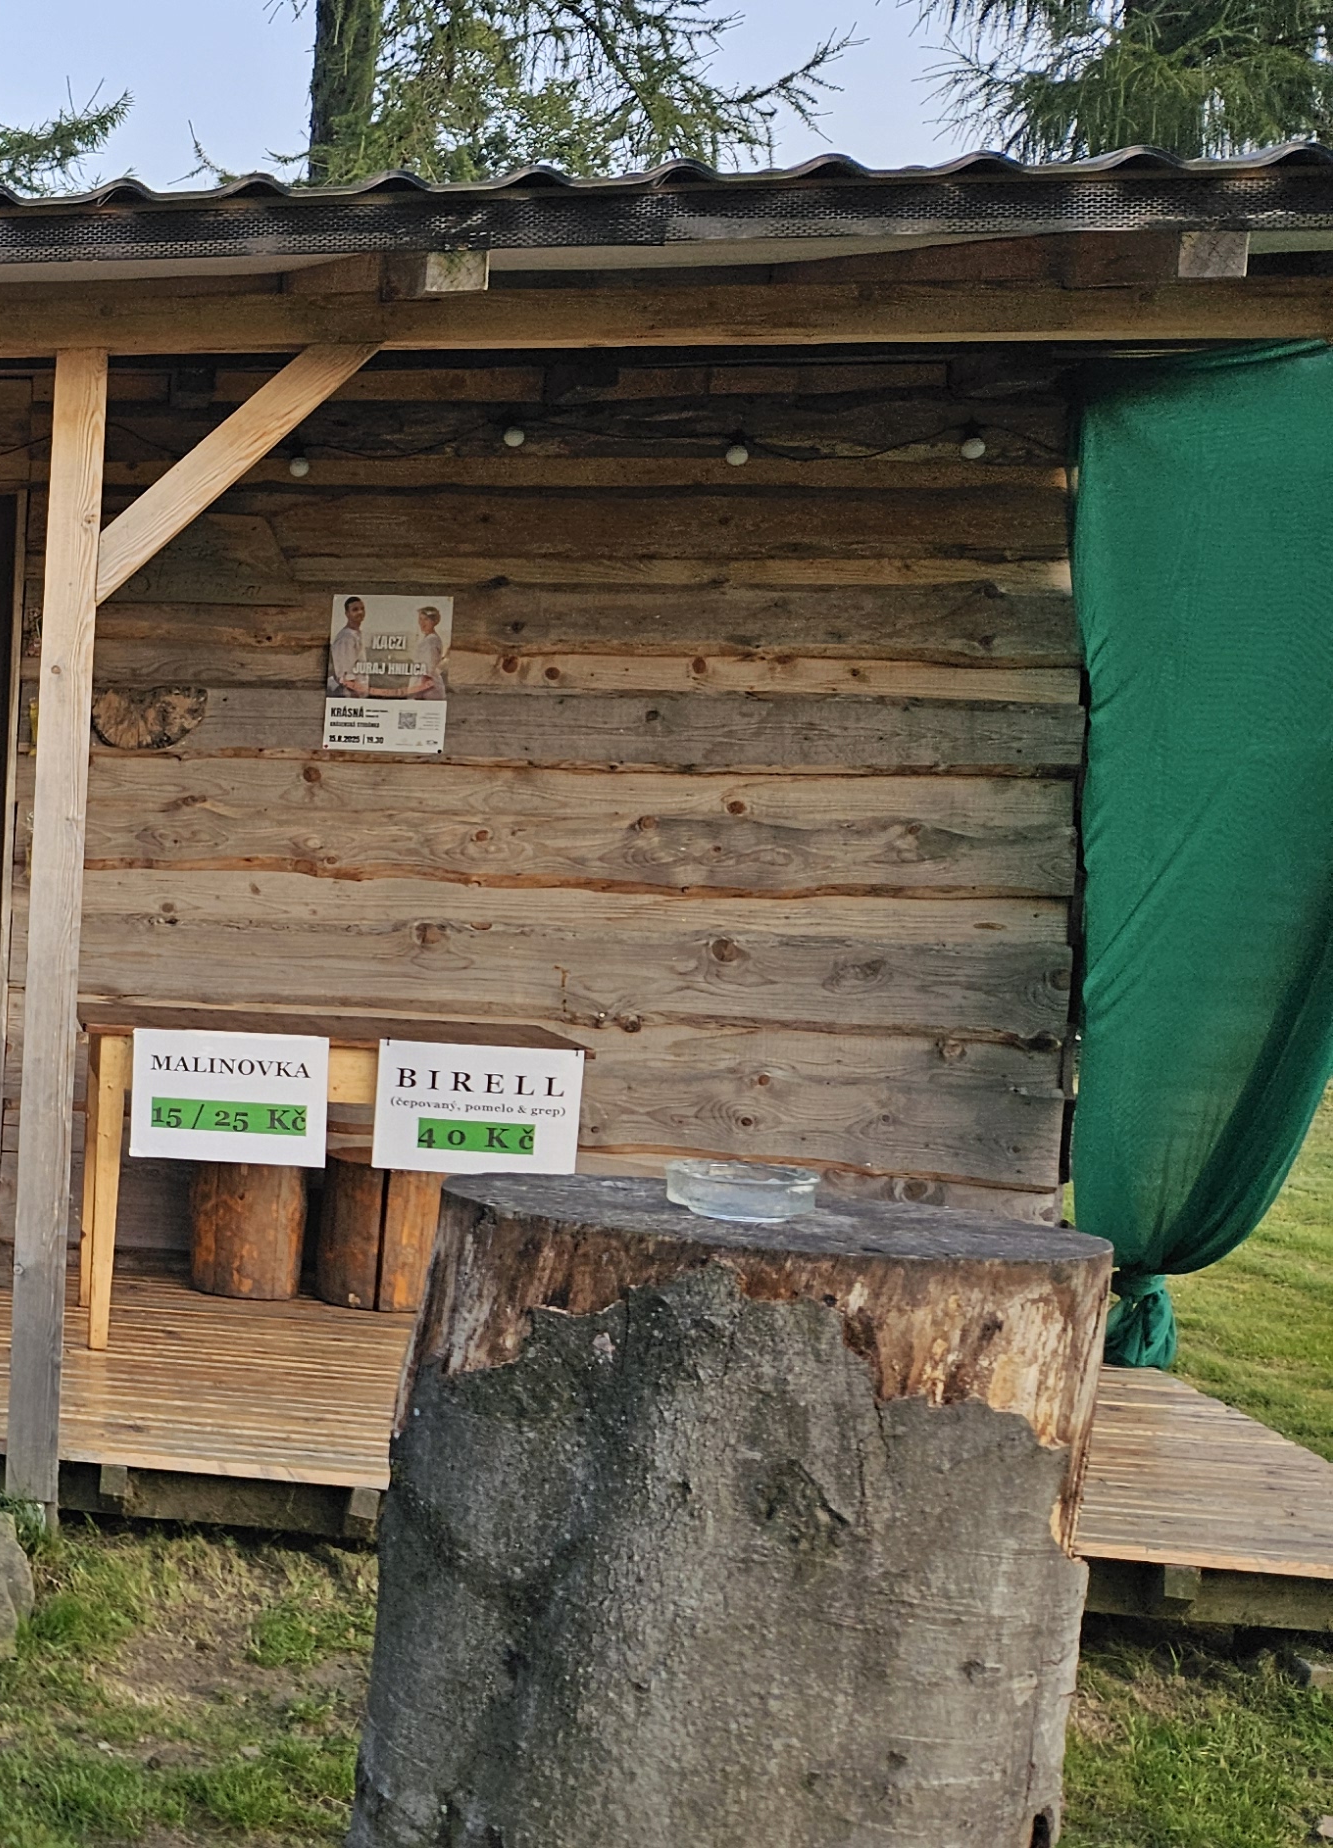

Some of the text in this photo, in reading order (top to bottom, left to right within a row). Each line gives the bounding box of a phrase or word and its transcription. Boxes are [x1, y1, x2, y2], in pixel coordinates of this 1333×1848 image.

[372, 635, 406, 650] KACZI
[353, 661, 428, 676] JURAJ HNILICA
[331, 706, 364, 718] KRÁSNÁ
[150, 1054, 311, 1079] MALINOVKA
[395, 1067, 565, 1098] BIRELL
[390, 1096, 566, 1118] (čepovaný, pomelo & grep)
[152, 1106, 182, 1129] 15
[214, 1110, 249, 1133] 25
[266, 1108, 307, 1132] Kč
[418, 1127, 533, 1150] 40 Kč
